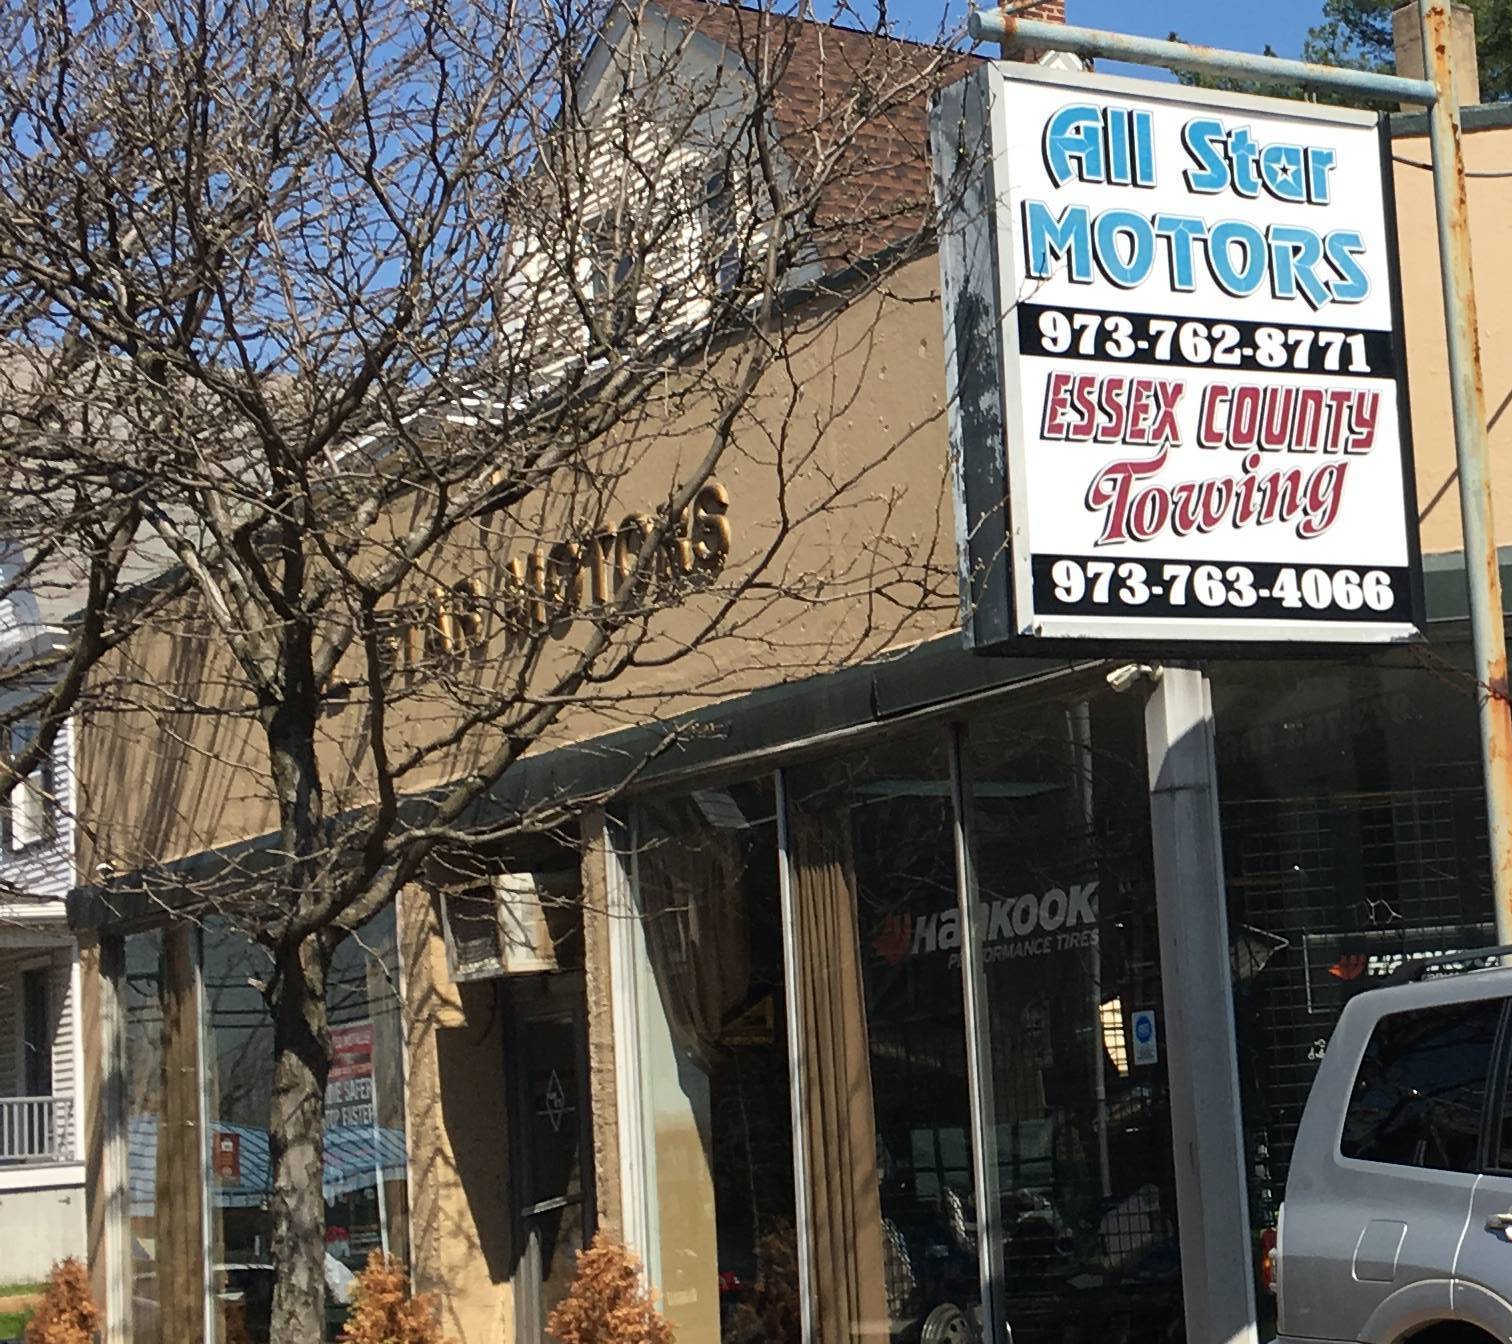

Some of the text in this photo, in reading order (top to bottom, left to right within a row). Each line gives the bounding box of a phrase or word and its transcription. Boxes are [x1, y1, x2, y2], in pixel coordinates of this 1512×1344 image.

[1041, 102, 1337, 205] All Star
[1021, 198, 1372, 311] MOTORS
[1038, 311, 1371, 374] 973-762-8771
[1040, 370, 1384, 455] ESSEX COUNTY
[1084, 445, 1353, 547] Towing
[1051, 559, 1395, 613] 973-763-4066
[948, 927, 1100, 969] PORMANCE TIRES
